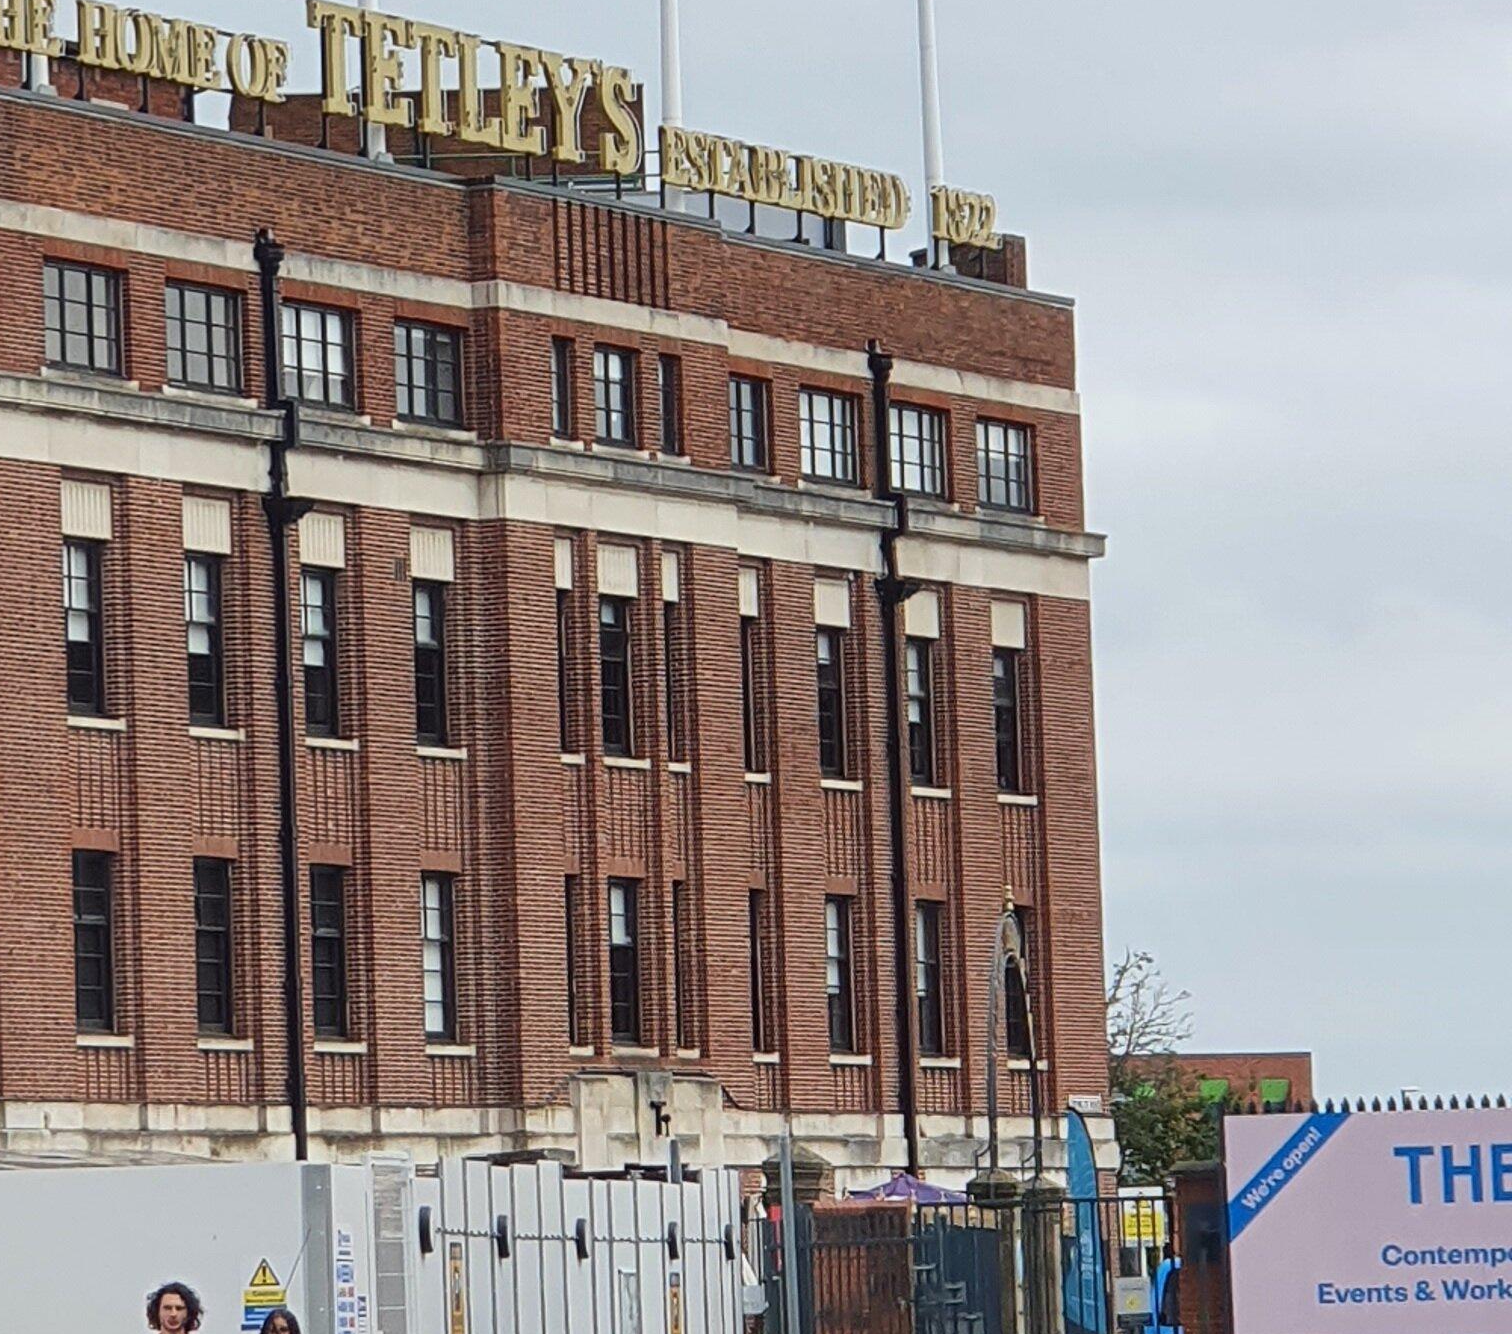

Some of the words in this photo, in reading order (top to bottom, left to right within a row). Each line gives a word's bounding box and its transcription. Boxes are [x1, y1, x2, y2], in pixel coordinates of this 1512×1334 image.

[226, 33, 291, 103] OF
[659, 125, 911, 230] ESTABLISHED
[930, 184, 1003, 250] 1822
[1241, 1169, 1285, 1210] We're
[1282, 1126, 1323, 1172] open!
[1392, 1143, 1512, 1205] THE
[1318, 1283, 1408, 1304] Events
[1414, 1280, 1436, 1302] &
[1441, 1277, 1512, 1301] Work
